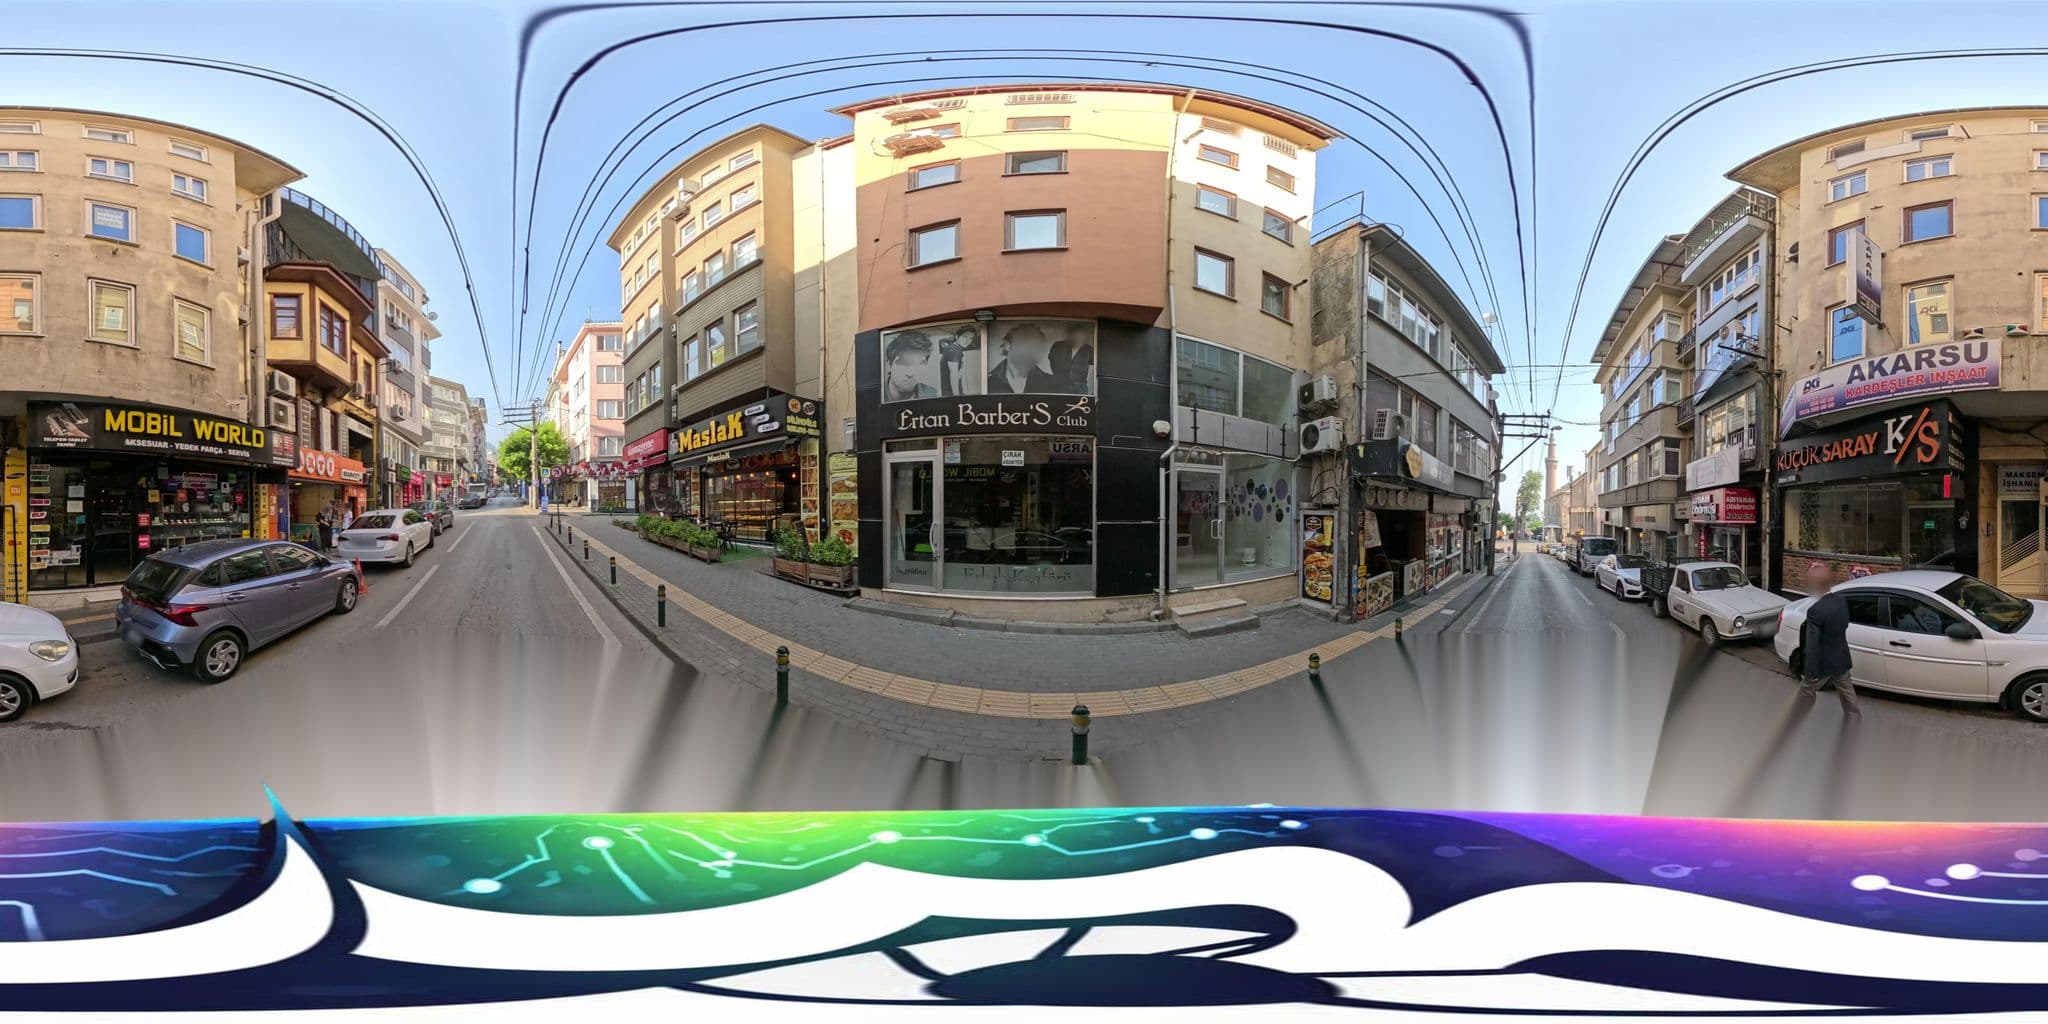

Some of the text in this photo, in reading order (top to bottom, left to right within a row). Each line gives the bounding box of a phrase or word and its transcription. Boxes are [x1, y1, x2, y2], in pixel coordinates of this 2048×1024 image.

[1847, 341, 1989, 385] AKARSU
[1845, 374, 1925, 399] KARDEŞLER
[1930, 366, 1988, 385] İNŞAAT
[193, 418, 265, 448] WORLD
[898, 408, 950, 431] Ertan
[1056, 415, 1088, 427] Club
[125, 438, 168, 448] AKSESUAR
[174, 443, 199, 451] YEDEK
[201, 446, 223, 455] PARÇA
[1777, 431, 1879, 471] KÜÇÜK SARAY
